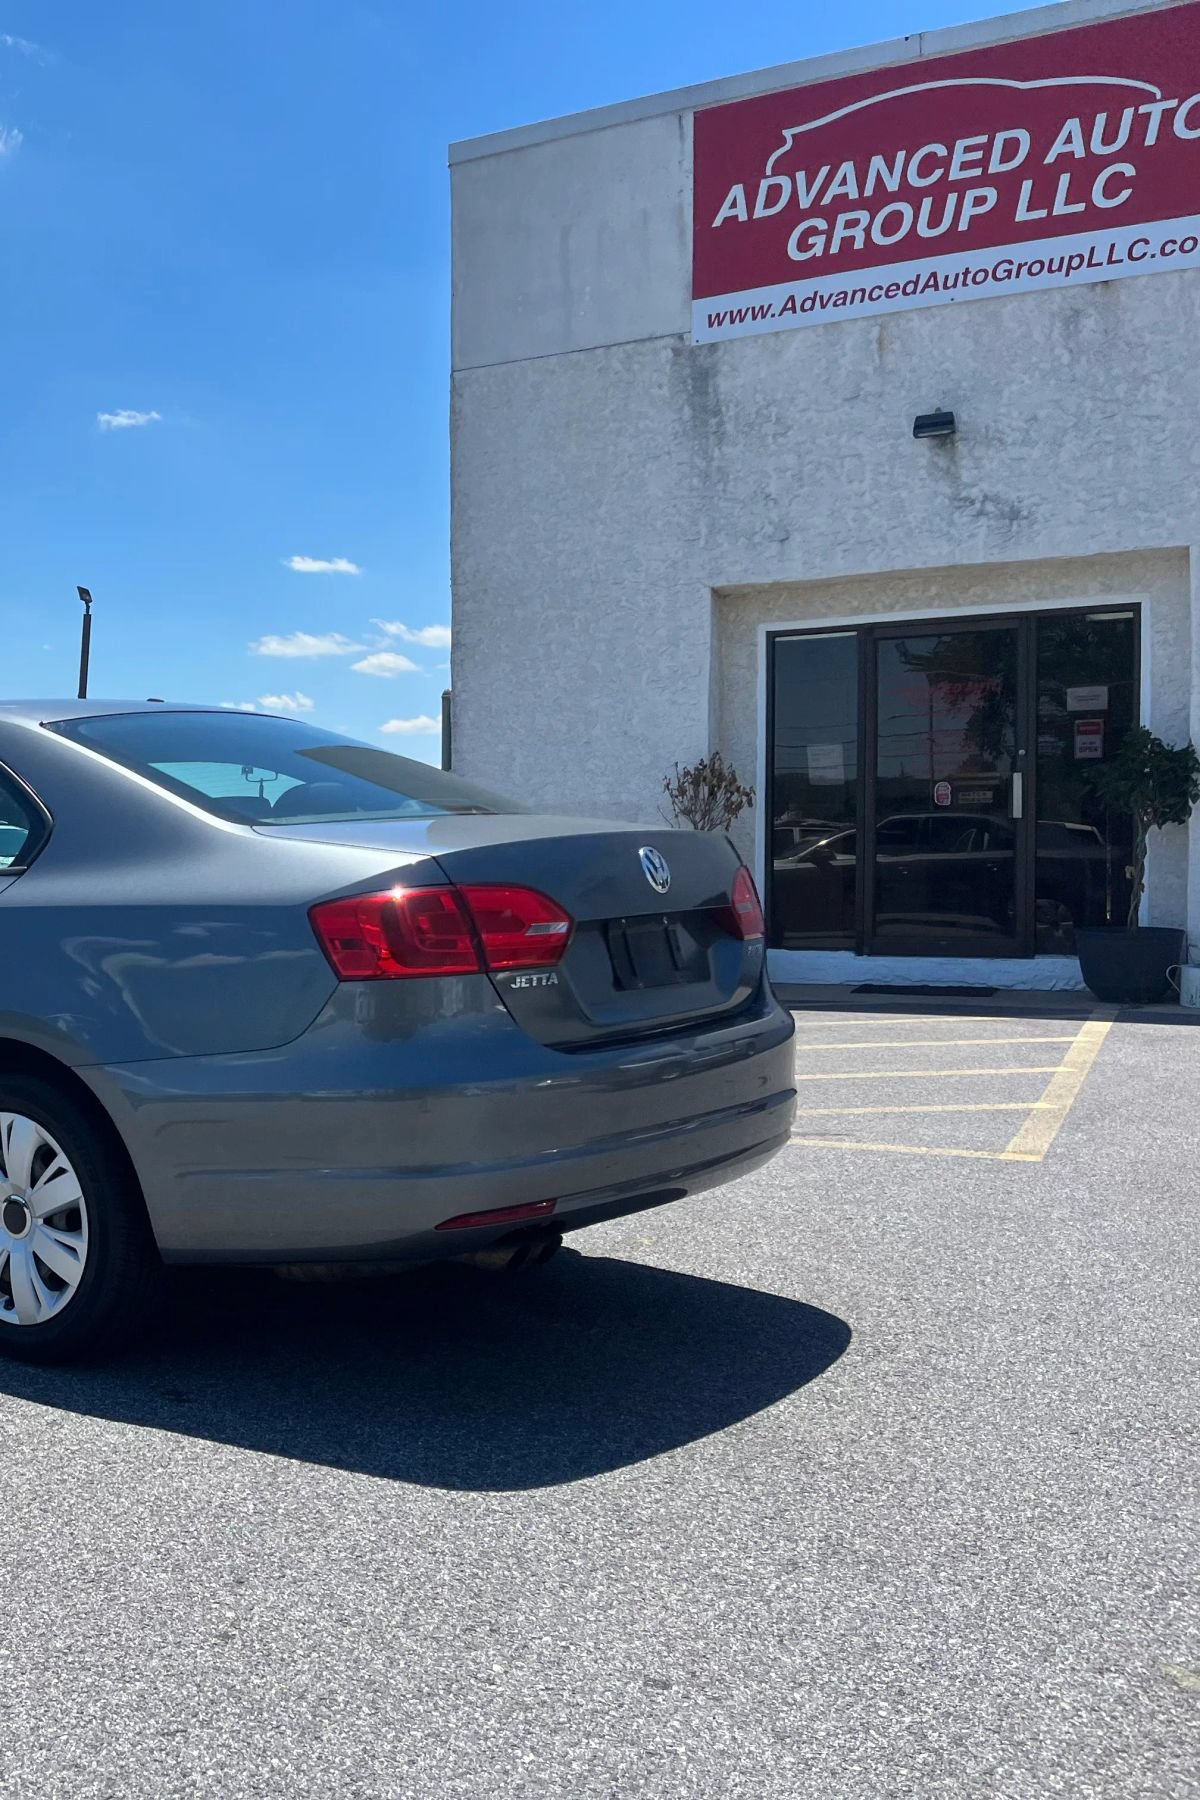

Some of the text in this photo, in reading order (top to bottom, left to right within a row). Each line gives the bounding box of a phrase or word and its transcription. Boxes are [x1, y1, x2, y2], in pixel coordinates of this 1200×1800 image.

[711, 92, 1200, 228] ADVANCED AUTO
[787, 162, 1137, 261] GROUP LLC
[707, 235, 1199, 329] www.AdvancedAutoGroupLLC.co
[510, 972, 559, 989] JETTA
